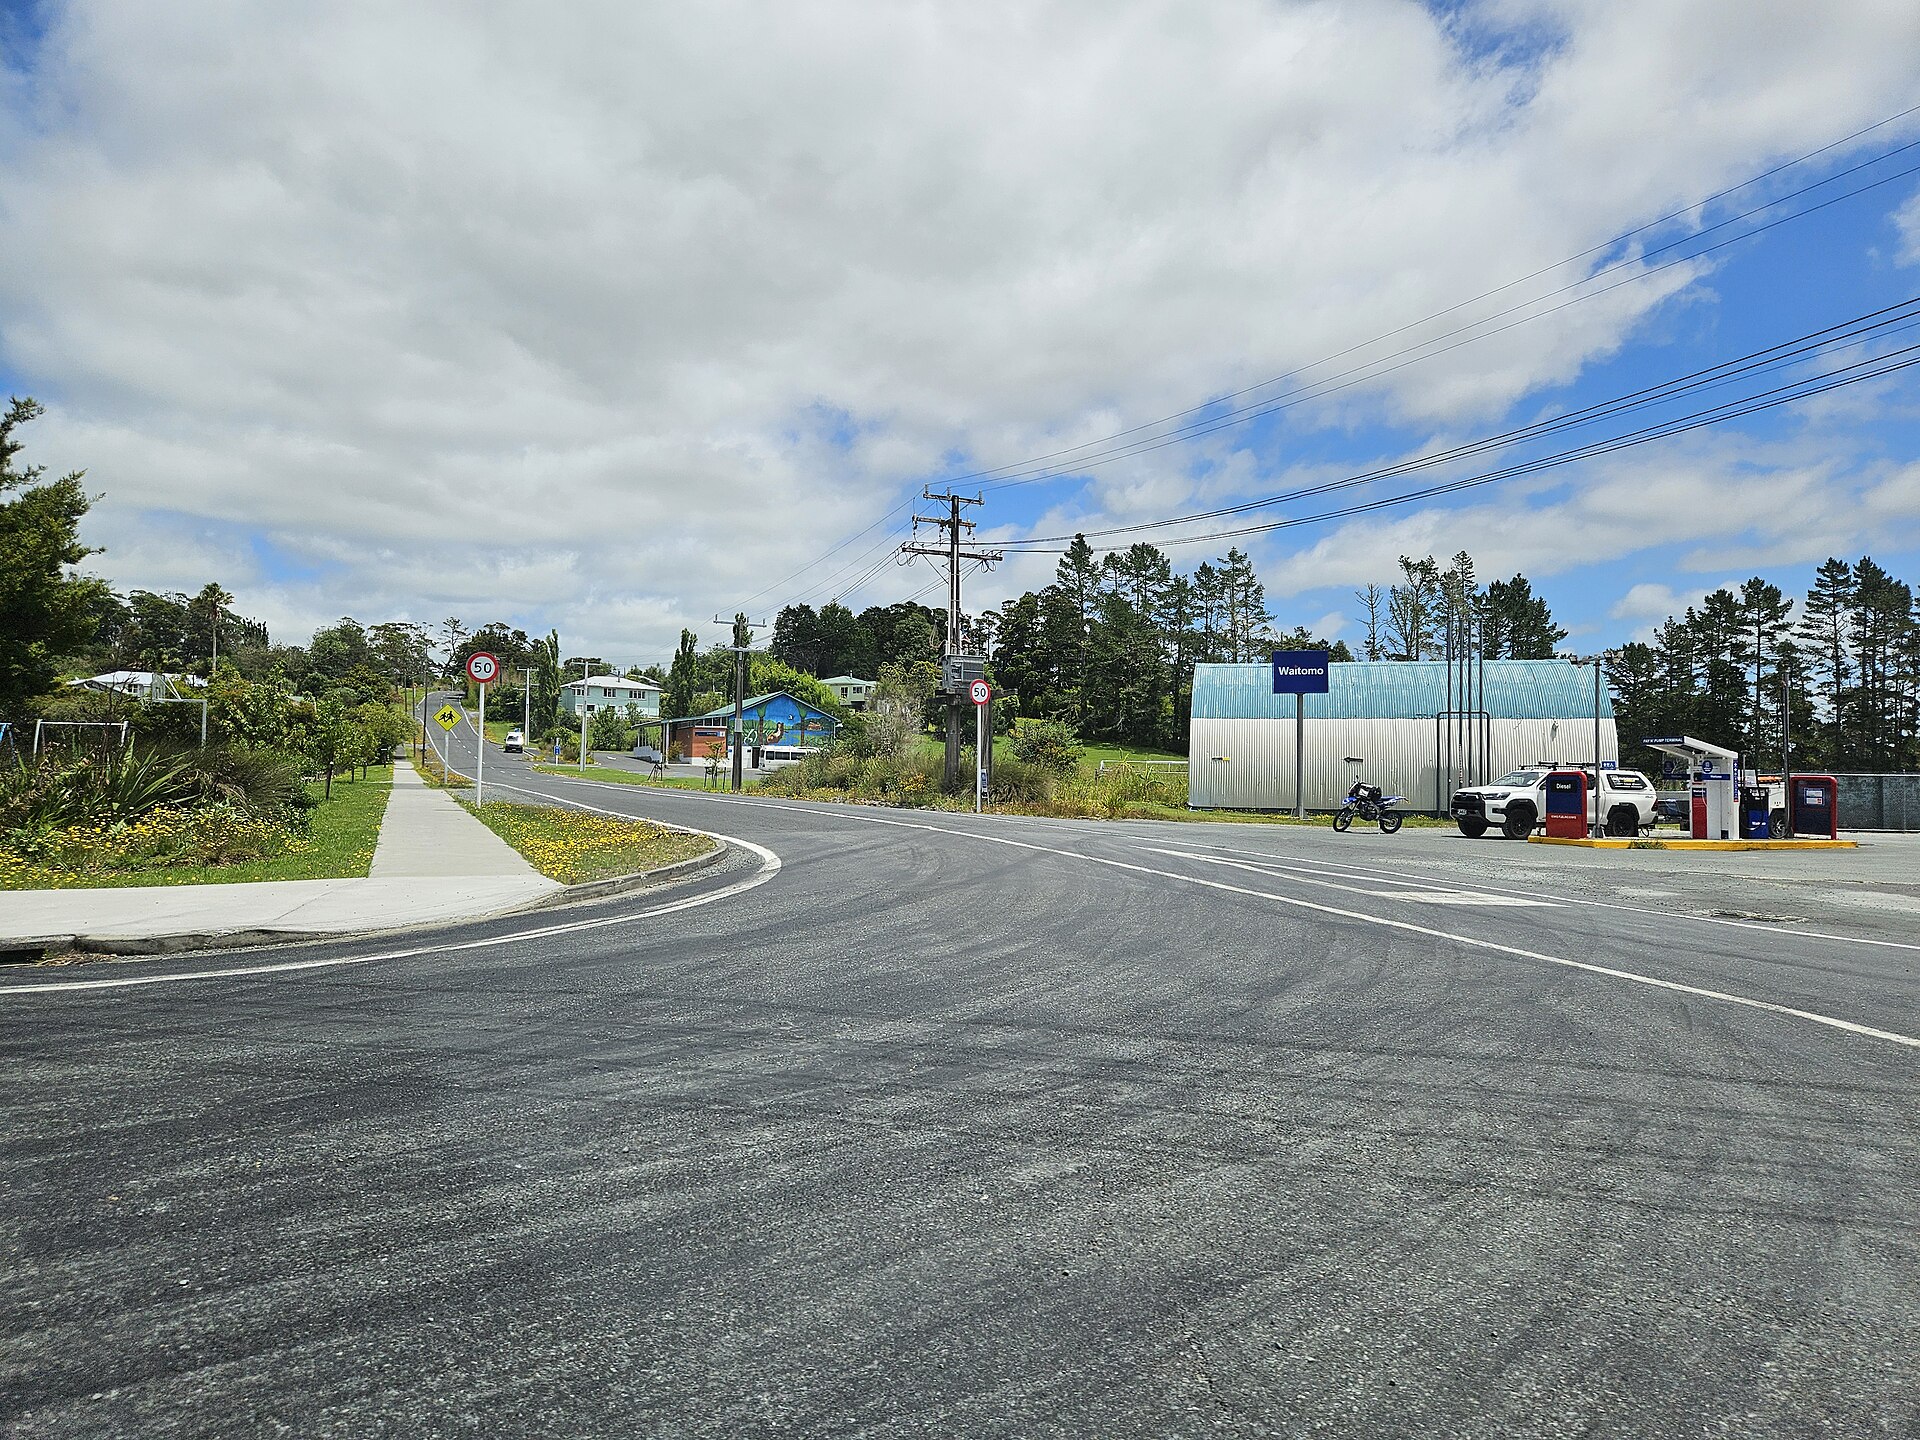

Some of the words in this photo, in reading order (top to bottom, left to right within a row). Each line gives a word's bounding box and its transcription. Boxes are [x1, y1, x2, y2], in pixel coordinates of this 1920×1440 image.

[473, 662, 492, 674] 50
[1278, 666, 1324, 676] Waitomo
[973, 687, 986, 698] 50
[1556, 782, 1571, 790] Diesel
